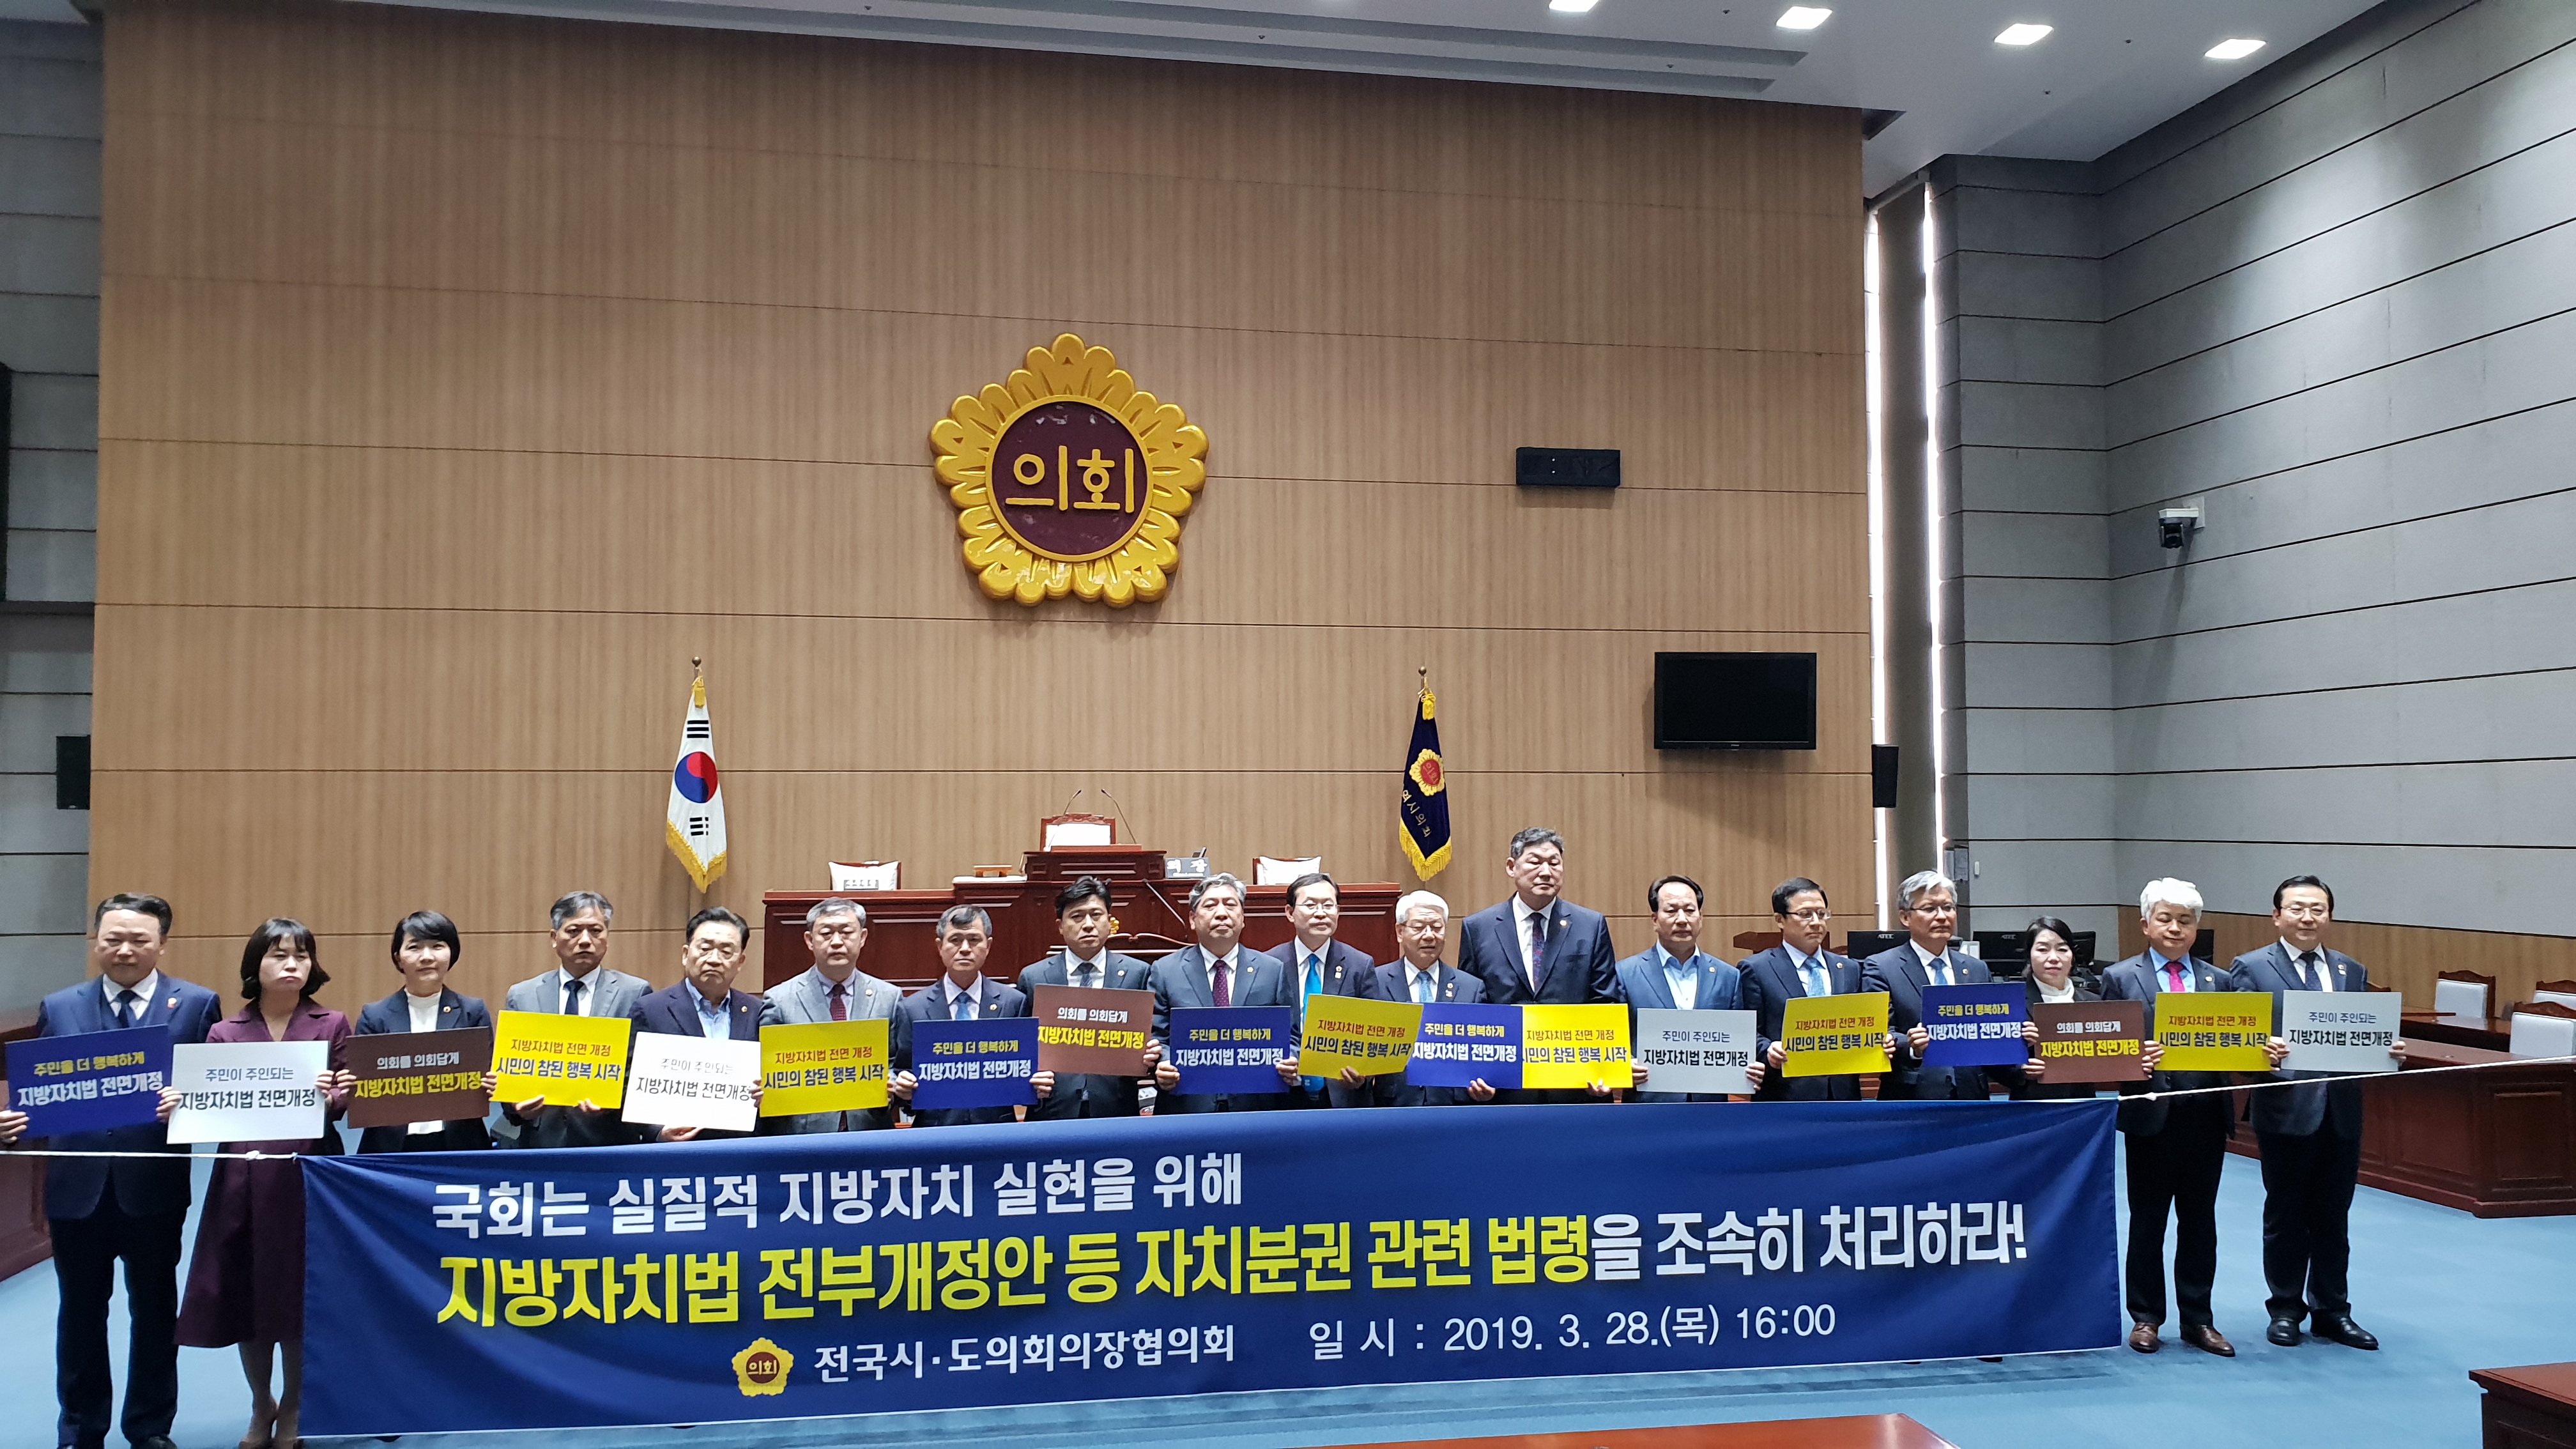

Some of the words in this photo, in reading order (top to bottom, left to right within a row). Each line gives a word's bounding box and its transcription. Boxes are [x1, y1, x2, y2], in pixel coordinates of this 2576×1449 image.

[1006, 445, 1134, 513] 의회
[1057, 1008, 1087, 1020] 의회를
[1089, 1009, 1128, 1023] 의회답게
[1938, 1005, 1963, 1016] 주민을
[1965, 1005, 1973, 1015] 더
[1975, 1004, 2009, 1015] 행복하게
[2310, 1012, 2337, 1022] 주민이
[2340, 1013, 2376, 1023] 주인되는
[1318, 1020, 1365, 1035] 지방자치법
[1367, 1025, 1385, 1036] 전면
[1387, 1027, 1406, 1038] 개정
[1425, 1023, 1453, 1036] 주민을
[1455, 1024, 1464, 1036] 더
[1466, 1024, 1505, 1037] 행복하게
[1795, 1019, 1837, 1031] 지방자치법
[1839, 1018, 1856, 1029] 전면
[1858, 1016, 1875, 1027] 개정
[2057, 1022, 2083, 1033] 의회를
[2085, 1021, 2120, 1032] 의회답게
[2169, 1016, 2214, 1027] 지방자치법
[2217, 1016, 2235, 1026] 전면
[2238, 1016, 2257, 1027] 개정
[1038, 1026, 1094, 1046] 지방자치법
[1098, 1030, 1145, 1049] 전면개정
[1190, 1029, 1218, 1041] 주민을
[1221, 1029, 1230, 1040] 더
[1233, 1029, 1271, 1040] 행복하게
[1526, 1031, 1572, 1041] 지방자치법
[1575, 1030, 1593, 1041] 전면
[1596, 1030, 1614, 1041] 개정
[1663, 1031, 1689, 1041] 주민이
[1694, 1032, 1729, 1043] 주인되는
[1926, 1023, 1977, 1040] 지방자치법
[1980, 1022, 2021, 1039] 전면개정
[2159, 1031, 2190, 1046] 시민의
[2195, 1032, 2216, 1046] 참된
[2220, 1032, 2242, 1048] 행복
[2245, 1032, 2268, 1048] 시작
[2290, 1030, 2347, 1046] 지방자치법
[2350, 1031, 2393, 1046] 전면개정
[511, 1039, 564, 1054] 지방자치법
[567, 1043, 588, 1055] 전면
[590, 1045, 611, 1057] 개정
[933, 1042, 963, 1055] 주민을
[965, 1041, 976, 1053] 더
[978, 1040, 1019, 1054] 행복하게
[1305, 1036, 1339, 1053] 시민의
[1342, 1039, 1364, 1057] 참된
[1367, 1042, 1388, 1058] 행복
[1390, 1043, 1412, 1059] 시작
[1412, 1040, 1468, 1060] 지방자치법
[1471, 1045, 1516, 1062] 전면개정
[1784, 1036, 1816, 1054] 시민의
[1818, 1035, 1838, 1051] 참된
[1841, 1034, 1861, 1050] 행복
[1864, 1032, 1885, 1048] 시작
[2041, 1040, 2094, 1057] 지방자치법
[2096, 1039, 2140, 1055] 전면개정
[377, 1055, 411, 1070] 의회를
[415, 1052, 459, 1066] 의회답게
[776, 1050, 827, 1064] 지방자치법
[830, 1048, 849, 1061] 전면
[852, 1046, 872, 1058] 개정
[1176, 1048, 1234, 1066] 지방자치법
[1236, 1047, 1284, 1066] 전면개정
[1554, 1047, 1575, 1063] 참된
[1579, 1047, 1601, 1063] 행복
[1604, 1046, 1627, 1062] 시작
[1644, 1050, 1699, 1066] 지방자치법
[1704, 1051, 1747, 1066] 전면개정
[34, 1060, 73, 1076] 주민을
[77, 1058, 89, 1071] 더
[93, 1052, 144, 1070] 행복하게
[495, 1057, 535, 1075] 시민의
[538, 1060, 564, 1078] 참된
[567, 1061, 592, 1079] 행복
[594, 1064, 621, 1082] 시작
[663, 1059, 691, 1070] 주민이
[695, 1062, 732, 1074] 주인되는
[919, 1061, 979, 1080] 지방자치법
[983, 1060, 1032, 1080] 전면개정
[206, 1069, 241, 1082] 주민이
[246, 1068, 293, 1080] 주인되는
[765, 1070, 801, 1089] 시민의
[805, 1068, 829, 1087] 참된
[832, 1066, 857, 1084] 행복
[860, 1064, 884, 1080] 시작
[18, 1079, 97, 1106] 지방자치법
[100, 1071, 164, 1097] 전면개정
[354, 1075, 423, 1098] 지방자치법
[427, 1071, 482, 1092] 전면개정
[637, 1077, 698, 1097] 지방자치법
[180, 1090, 255, 1110] 지방자치법
[258, 1089, 315, 1108] 전면개정
[433, 1182, 589, 1238] 국회는
[608, 1174, 758, 1234] 실질적
[779, 1164, 973, 1224] 지방자치
[994, 1158, 1135, 1216] 실현을
[1153, 1153, 1241, 1208] 위해
[437, 1251, 739, 1327] 지방자치법
[758, 1236, 1053, 1320] 전부개정안
[1064, 1232, 1120, 1303] 등
[1135, 1221, 1351, 1297] 자치분권
[1367, 1218, 1471, 1288] 관련
[1489, 1213, 1642, 1285] 법령을
[1656, 1208, 1804, 1276] 조속히
[1819, 1200, 2027, 1270] 처리하라!
[1310, 1321, 1344, 1361] 일
[1360, 1318, 1394, 1357] 시
[1445, 1315, 1542, 1351] 2019.
[1559, 1314, 1590, 1348] 3.
[1606, 1304, 1719, 1347] 28.(목)
[1736, 1304, 1836, 1339] 16:00
[747, 1360, 777, 1375] 의회
